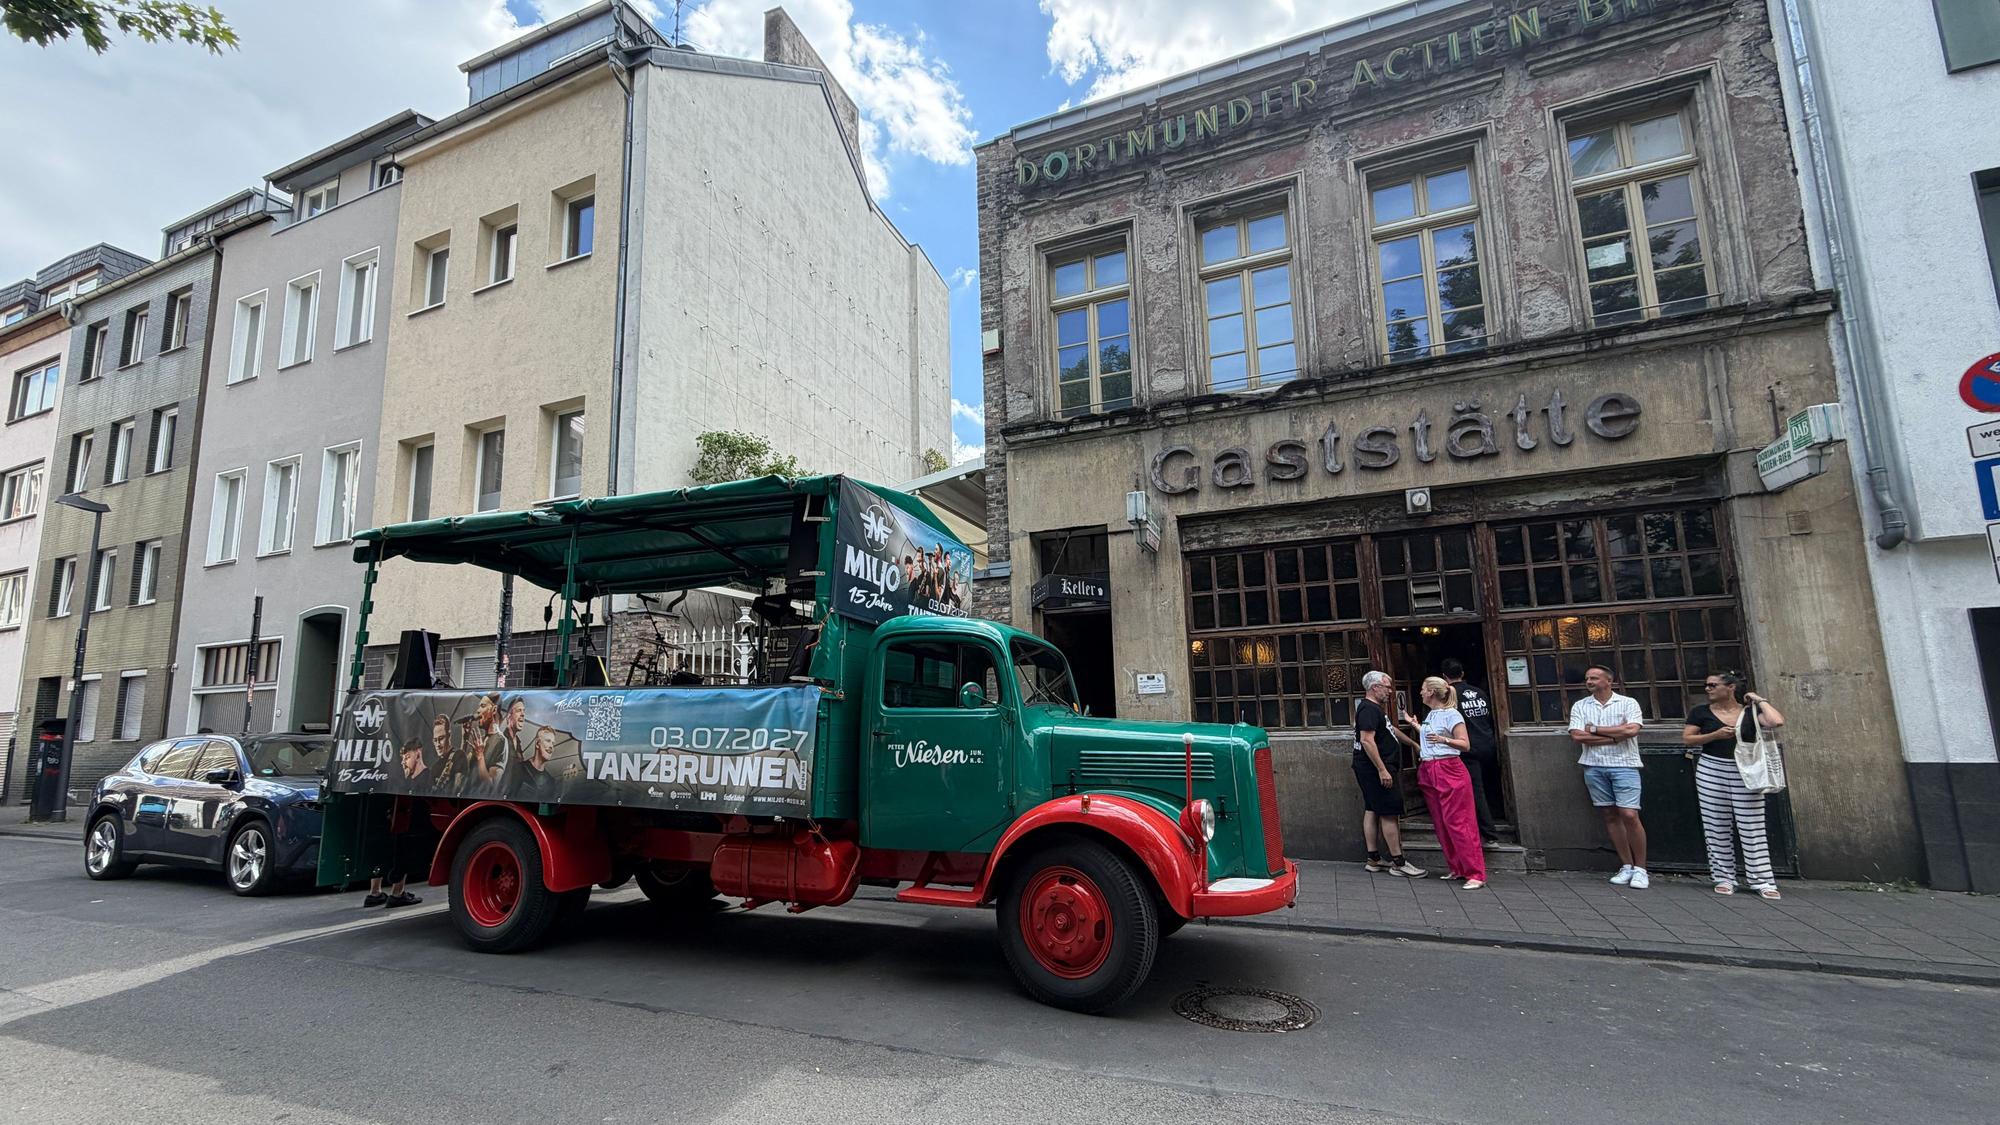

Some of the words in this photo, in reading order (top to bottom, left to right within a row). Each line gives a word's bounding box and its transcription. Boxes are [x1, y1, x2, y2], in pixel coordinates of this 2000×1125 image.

[1016, 77, 1319, 187] DORTMUNDER
[1151, 388, 1642, 494] Gaststätte
[1792, 421, 1810, 441] DAB
[1758, 440, 1790, 462] DORTMUNDER
[1760, 451, 1792, 473] ACTIEN-BIER
[849, 586, 868, 603] 15
[866, 593, 893, 611] Jahre
[1061, 578, 1096, 596] Keller
[555, 697, 583, 714] Tickets
[651, 726, 808, 752] 03.07.2027
[896, 740, 968, 768] Niesen
[338, 768, 354, 781] 15
[352, 768, 388, 783] Jahre
[582, 752, 806, 790] TANZBRUNNEN
